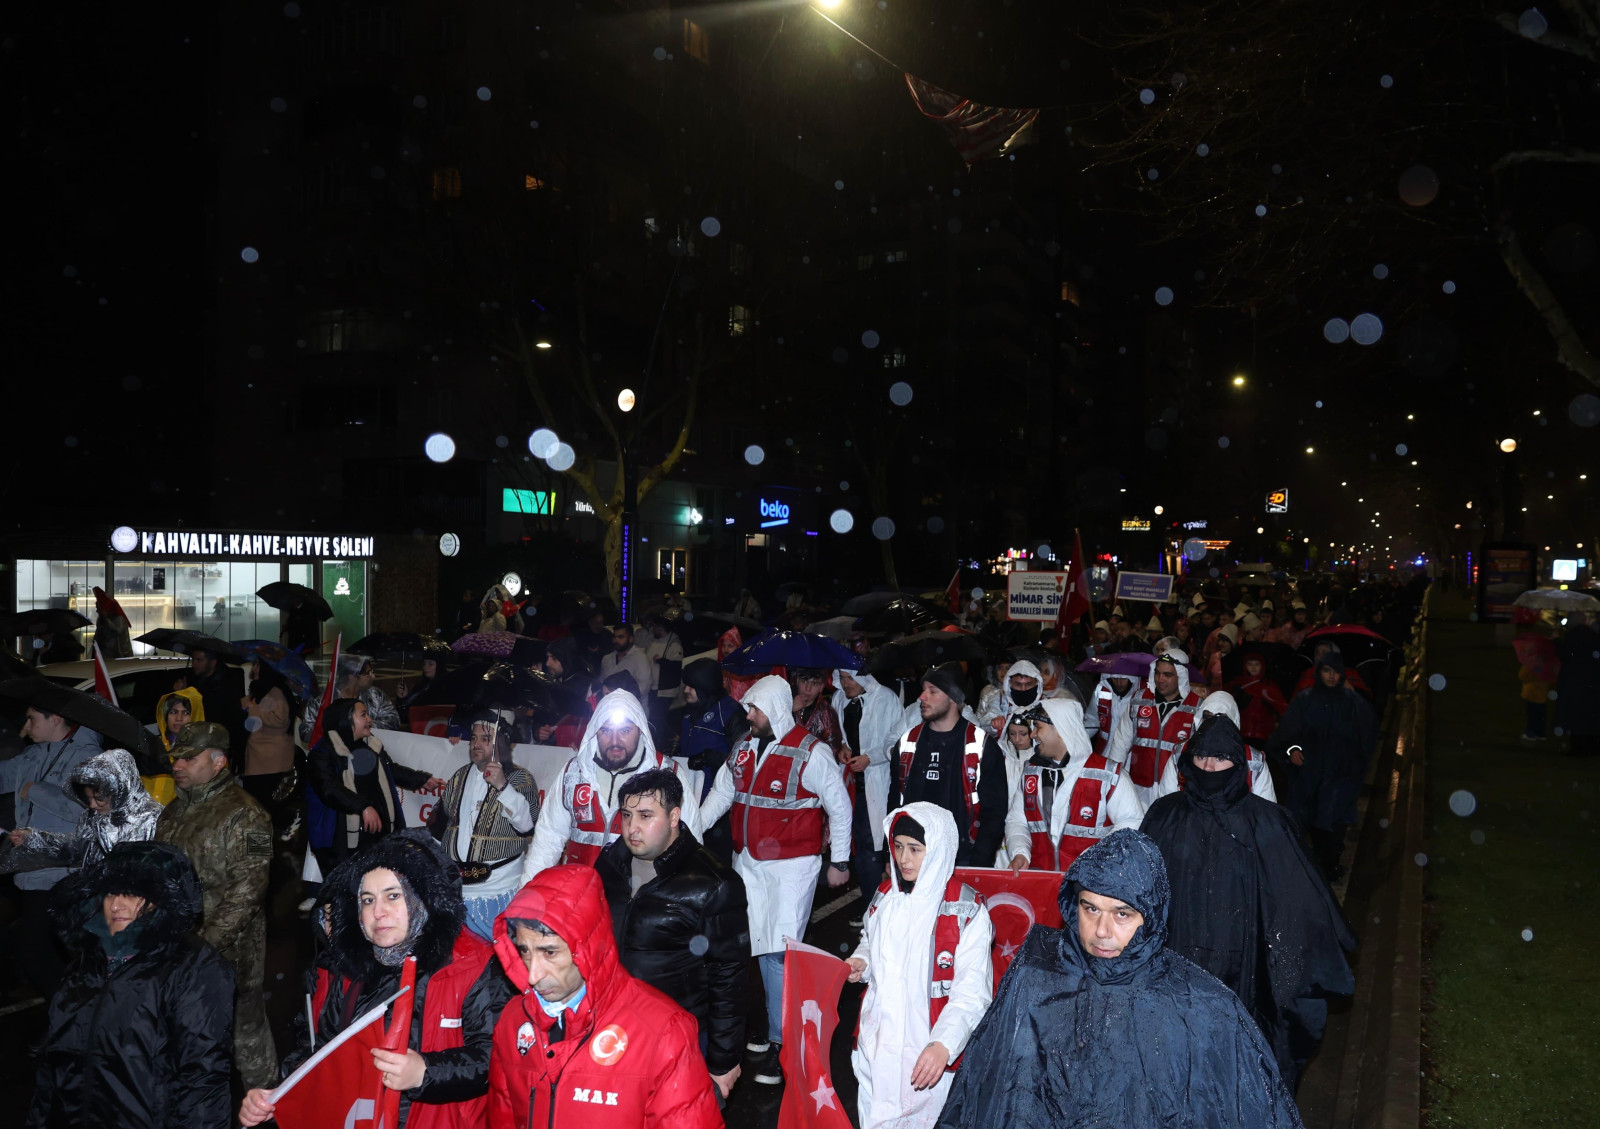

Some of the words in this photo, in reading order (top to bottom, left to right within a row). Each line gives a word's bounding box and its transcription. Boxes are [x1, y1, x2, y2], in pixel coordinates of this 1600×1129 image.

[760, 498, 789, 518] beko
[1010, 592, 1044, 604] MİMAR
[1046, 593, 1063, 604] SİN
[1010, 606, 1041, 615] MAHALLESİ
[1042, 607, 1058, 615] MUHT
[573, 1087, 618, 1106] MAK
